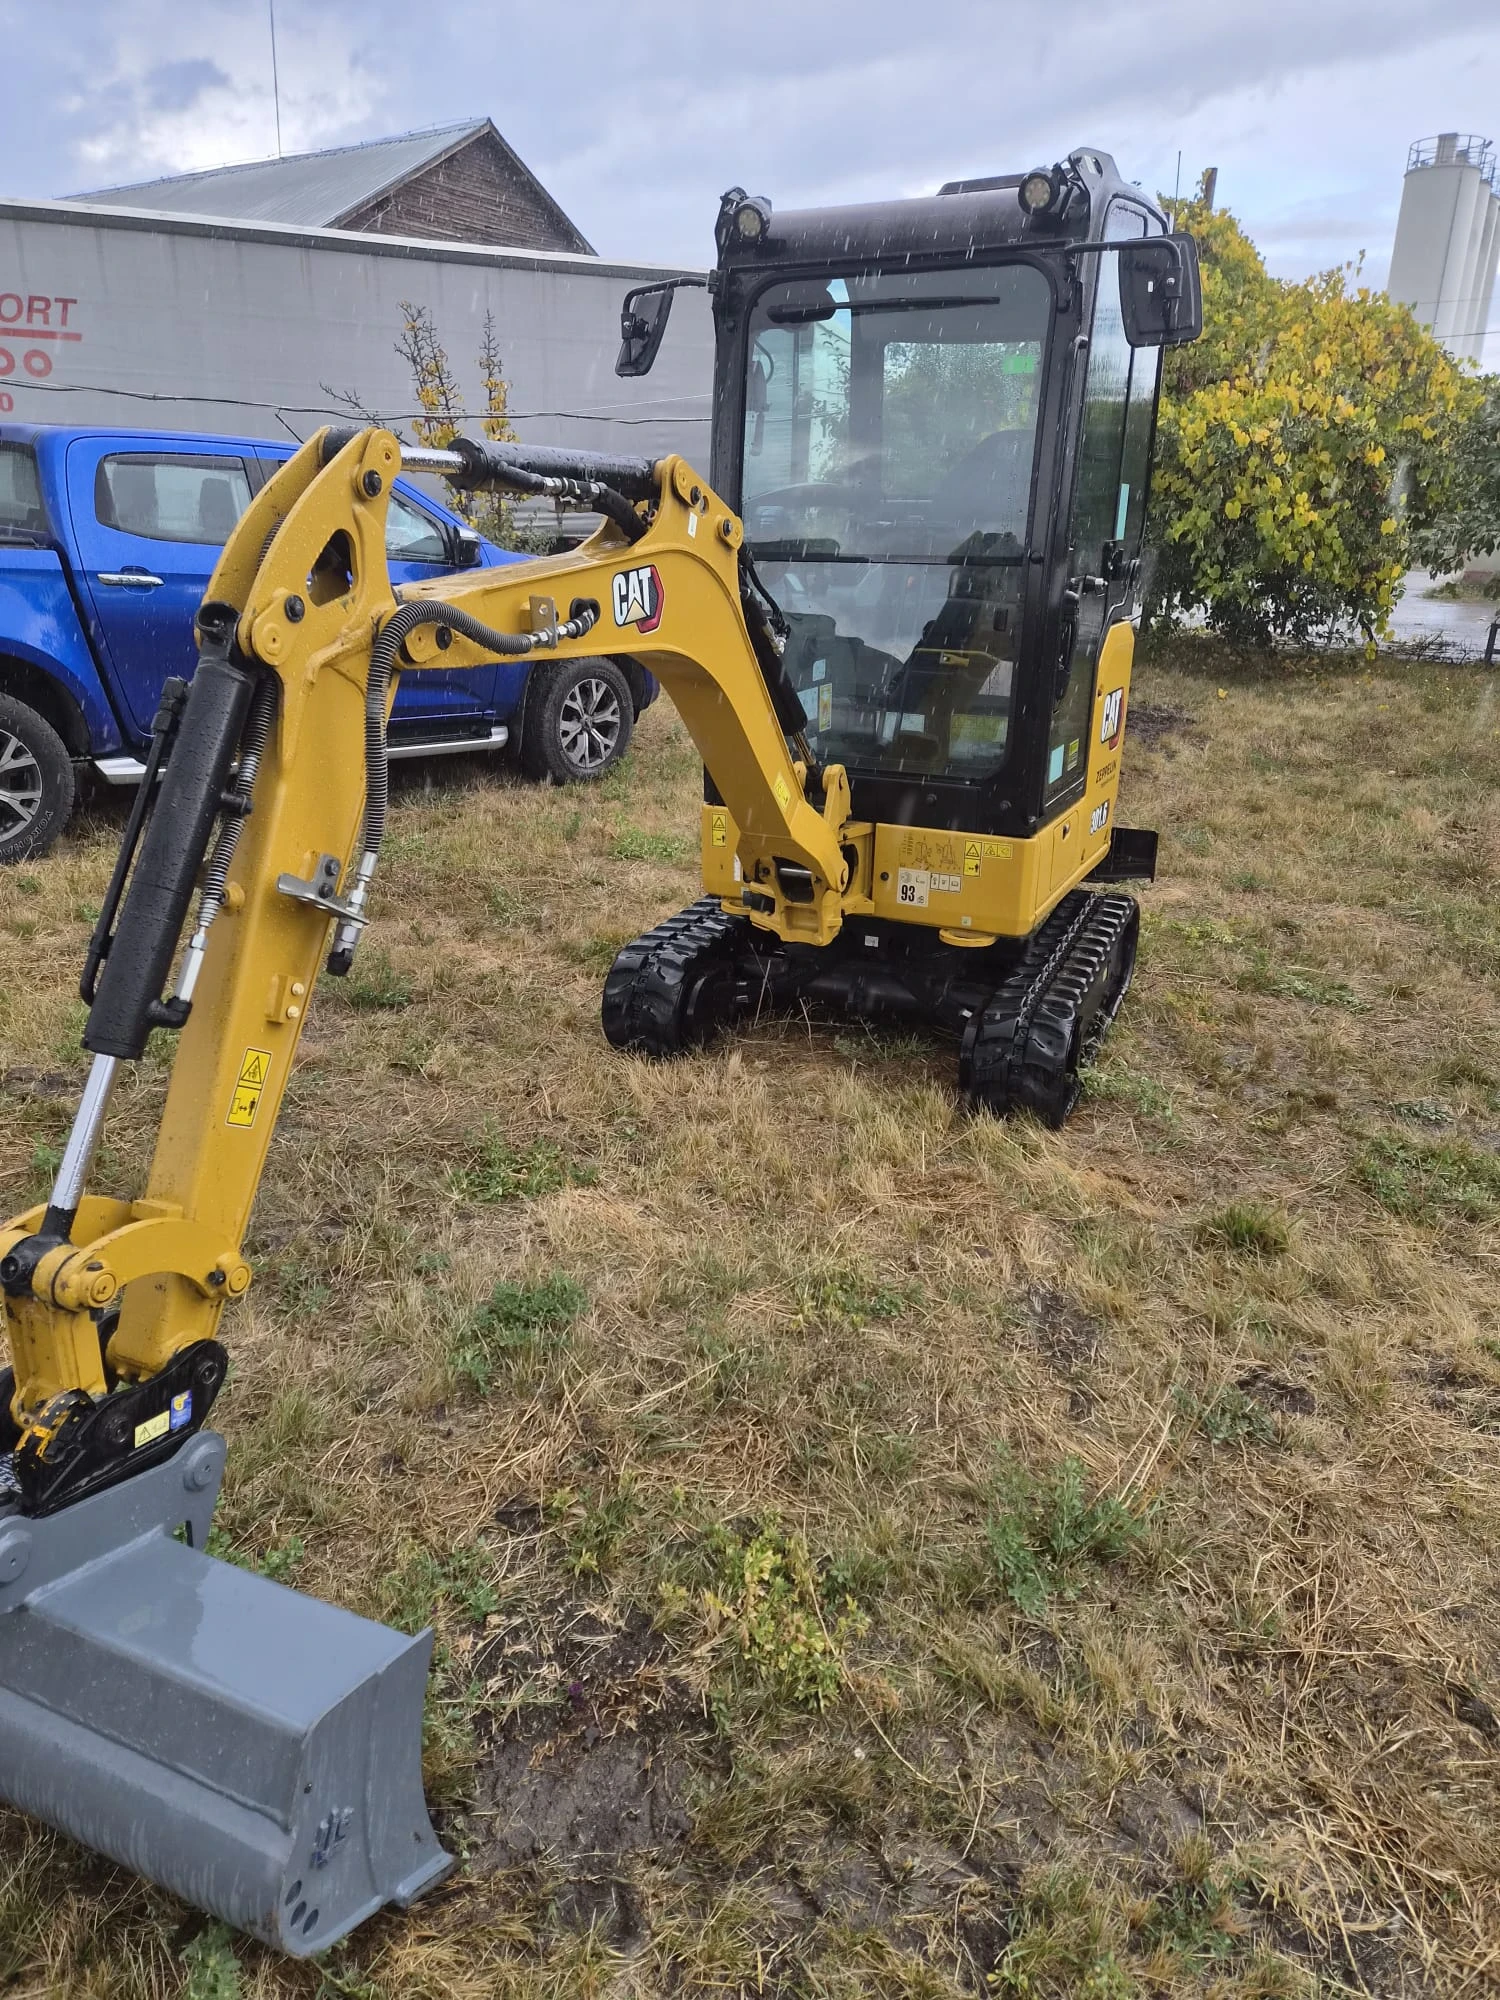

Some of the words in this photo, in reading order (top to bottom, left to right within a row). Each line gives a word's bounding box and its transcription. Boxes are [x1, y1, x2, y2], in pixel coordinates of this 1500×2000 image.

[0, 292, 78, 327] ORT
[612, 565, 652, 627] CAT
[1101, 688, 1123, 743] CAT
[1096, 760, 1117, 784] ZEPPELIN
[901, 884, 916, 902] 93
